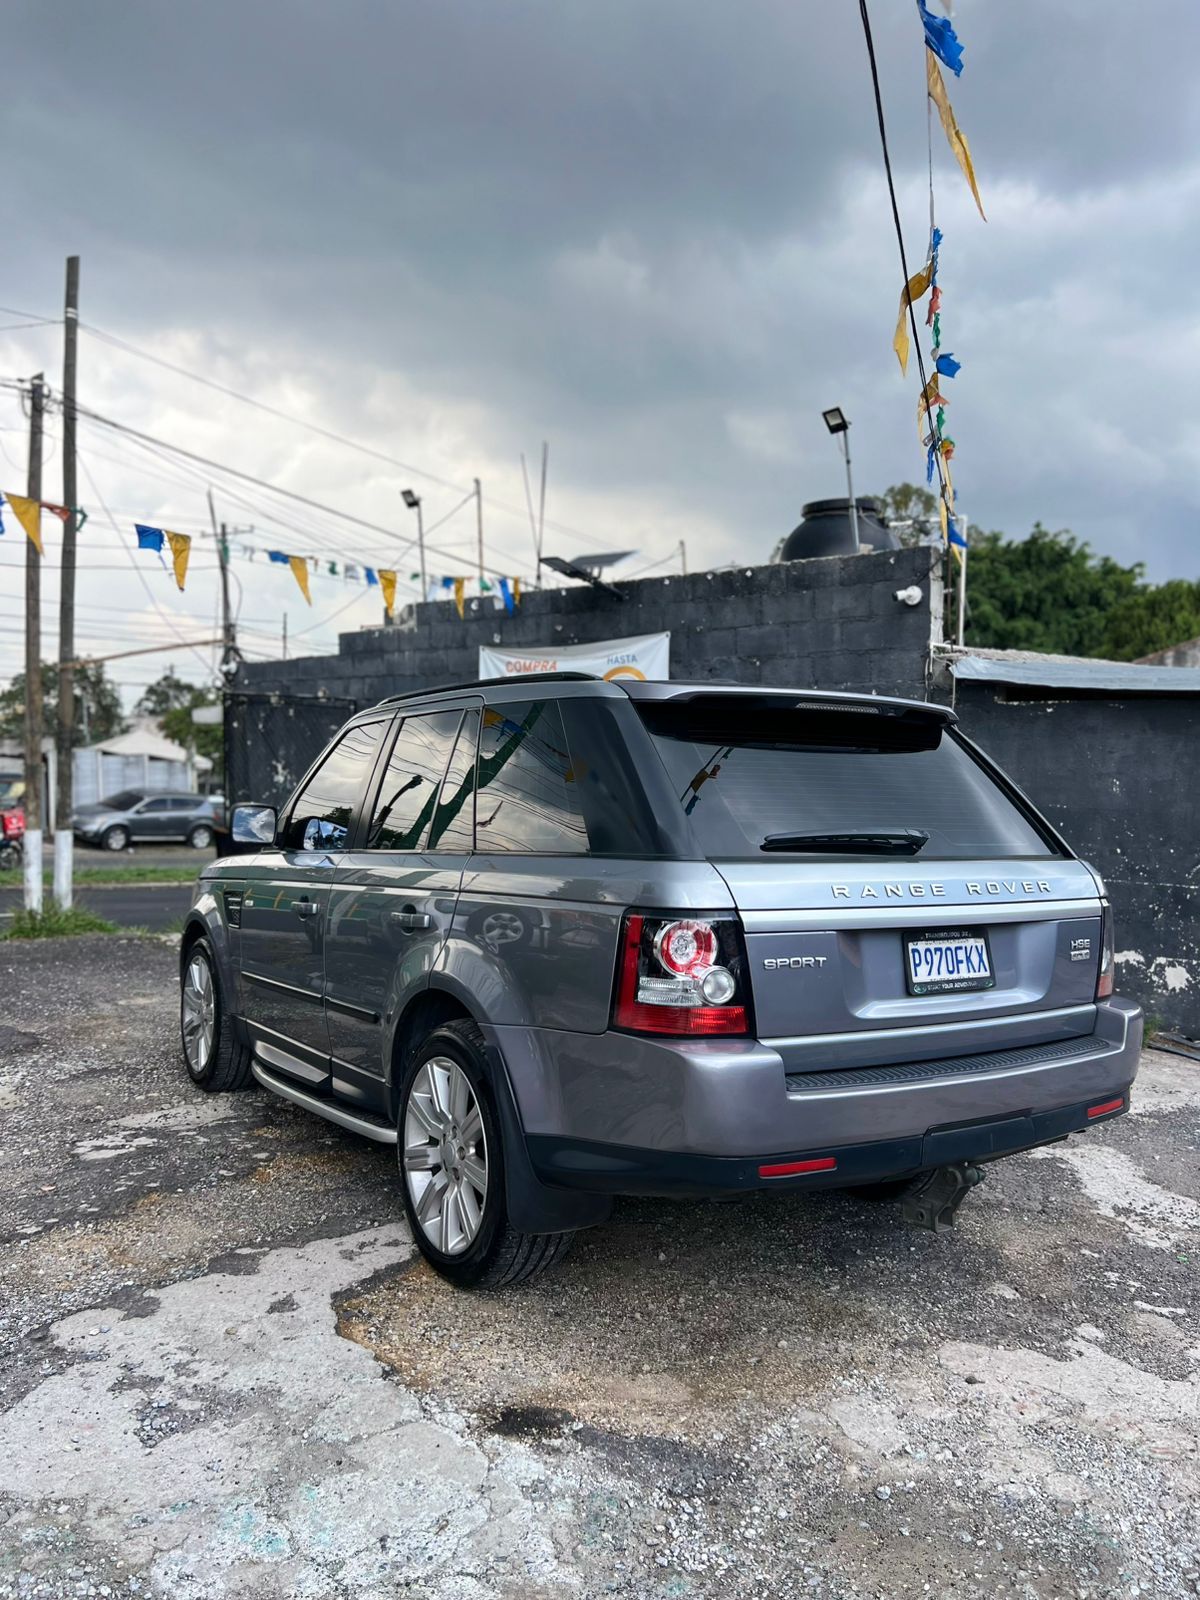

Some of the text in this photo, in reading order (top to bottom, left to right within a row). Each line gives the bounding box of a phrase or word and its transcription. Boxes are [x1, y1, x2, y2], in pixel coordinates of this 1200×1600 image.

[607, 654, 637, 665] HASTA
[506, 660, 557, 673] COMPRA
[831, 879, 1052, 899] RANGE ROVER
[1070, 938, 1091, 950] HSE
[763, 956, 827, 970] SPORT
[911, 945, 988, 977] P970FKX
